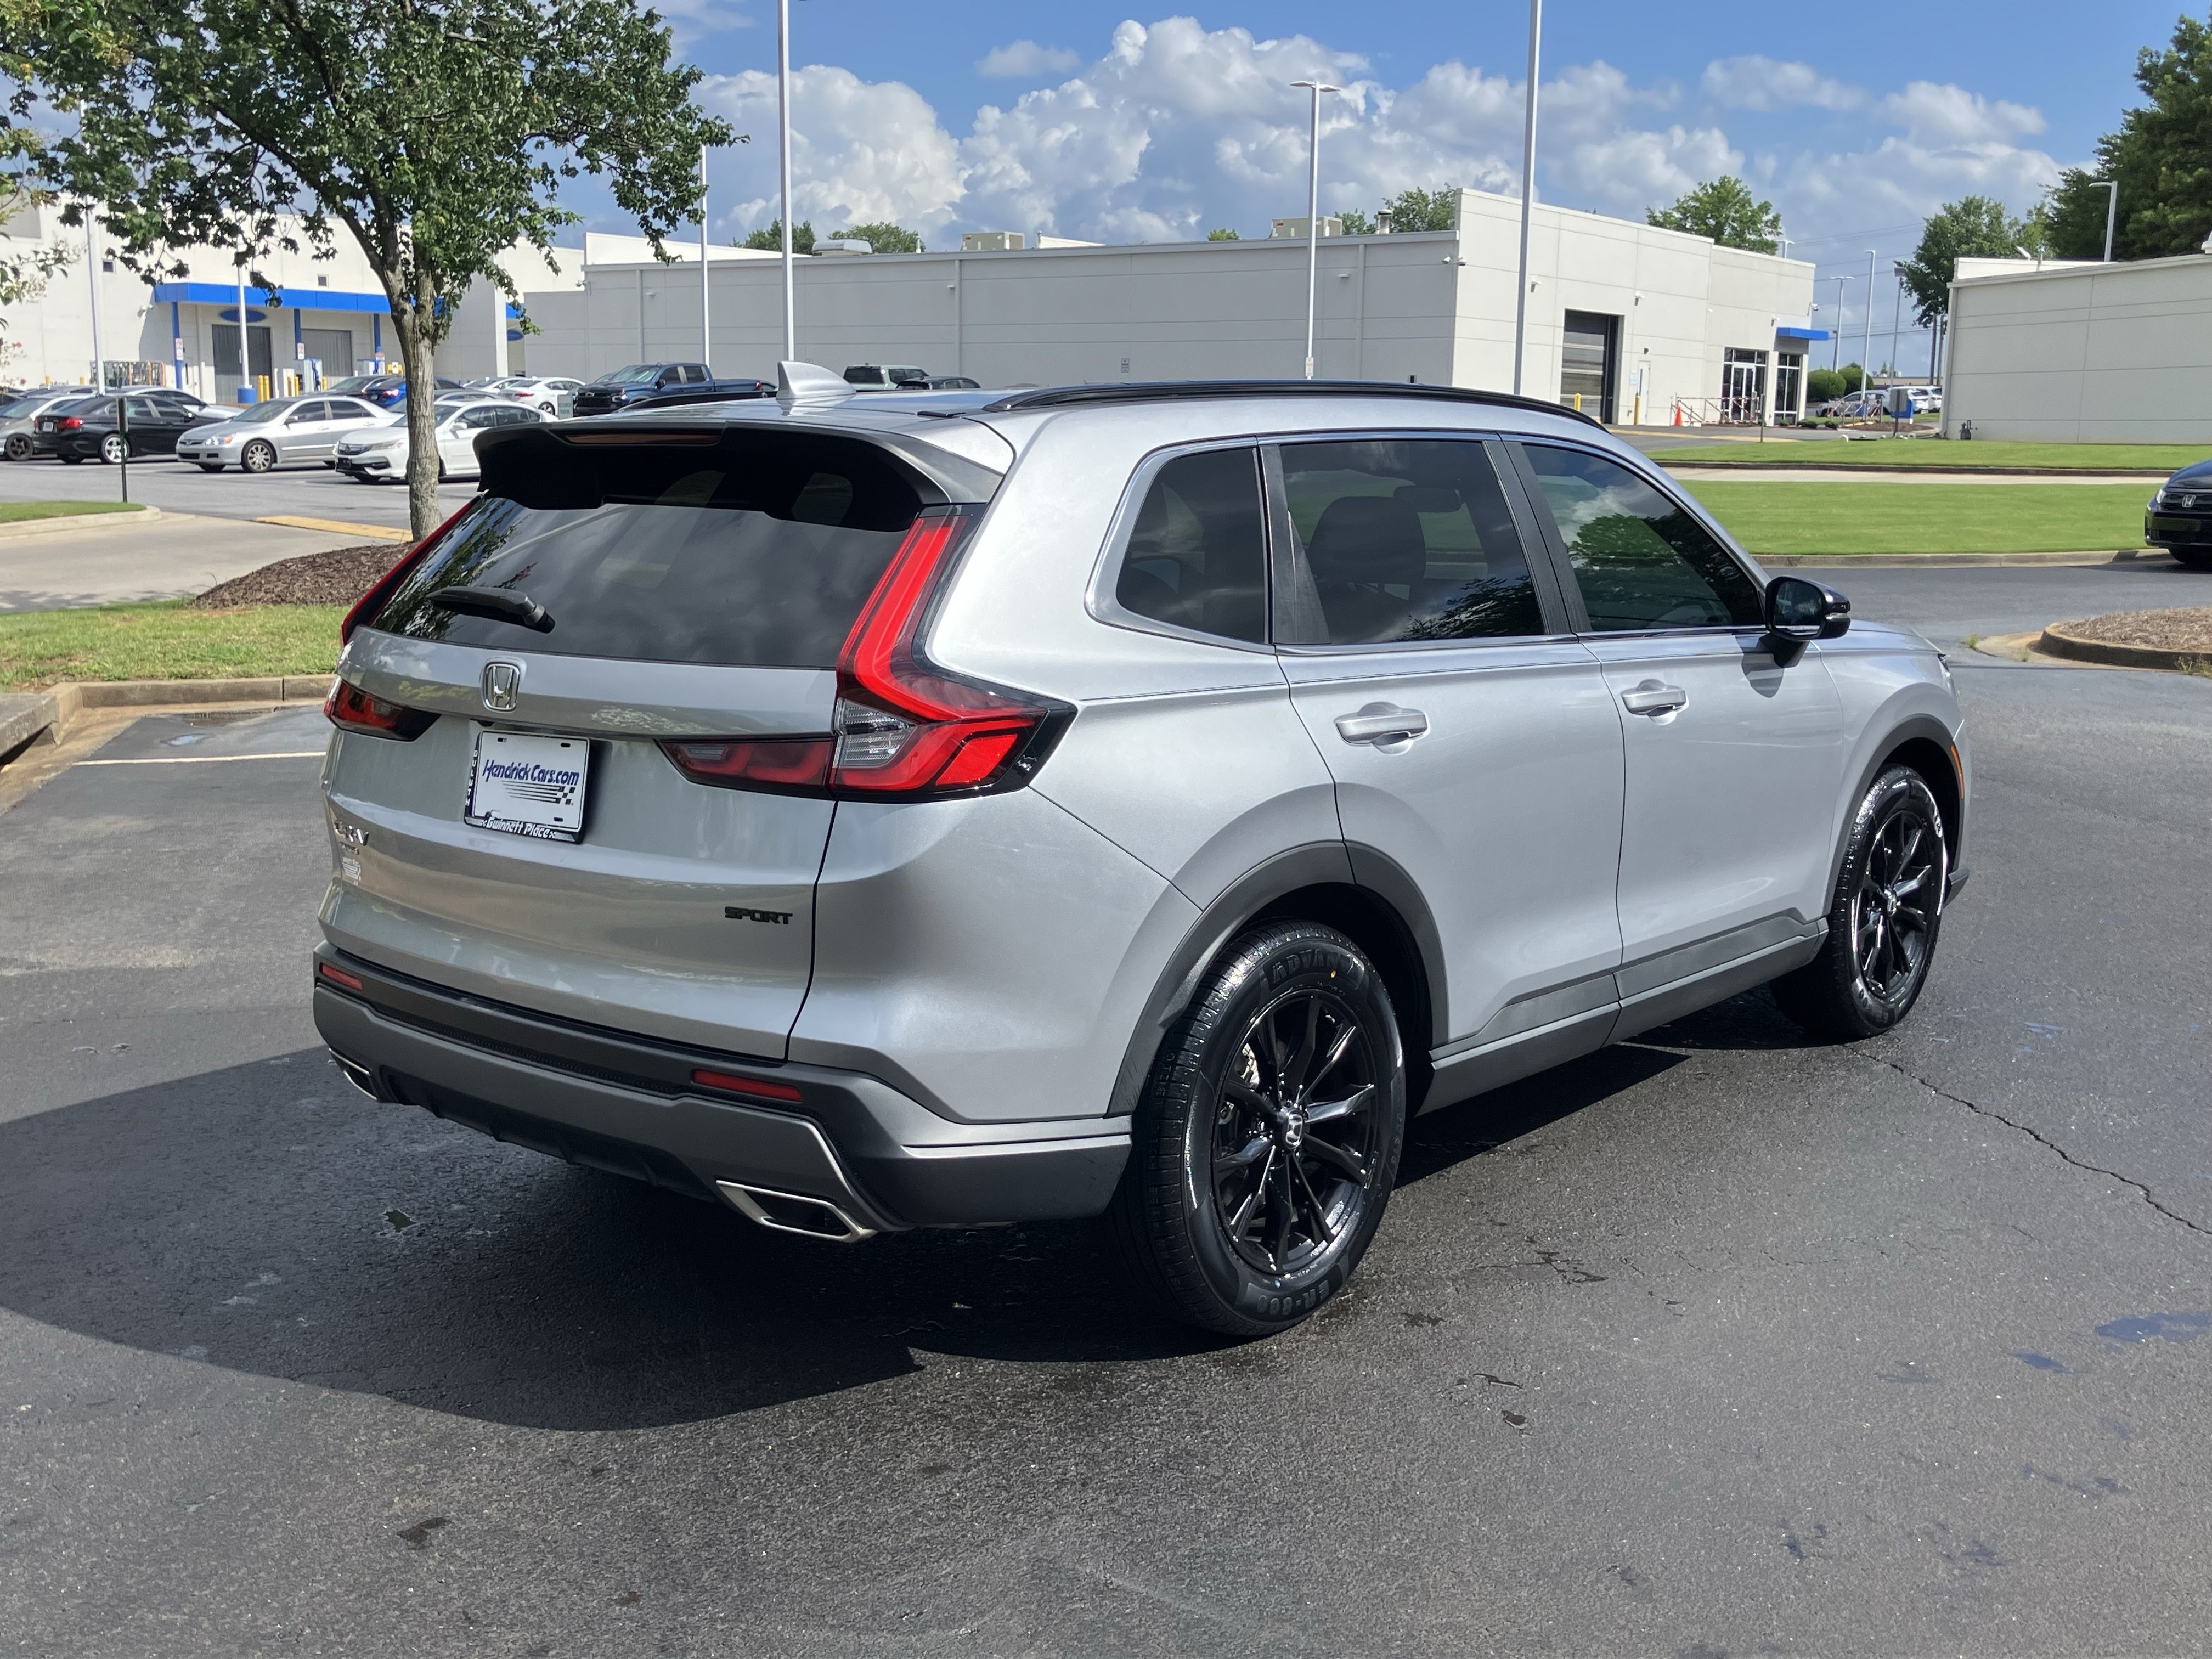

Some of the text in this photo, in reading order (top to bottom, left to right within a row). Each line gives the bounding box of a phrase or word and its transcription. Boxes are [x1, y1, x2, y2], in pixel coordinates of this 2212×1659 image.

[465, 750, 478, 806] DULUTH
[486, 817, 550, 838] Gwinnett Place
[725, 906, 793, 924] SPORT
